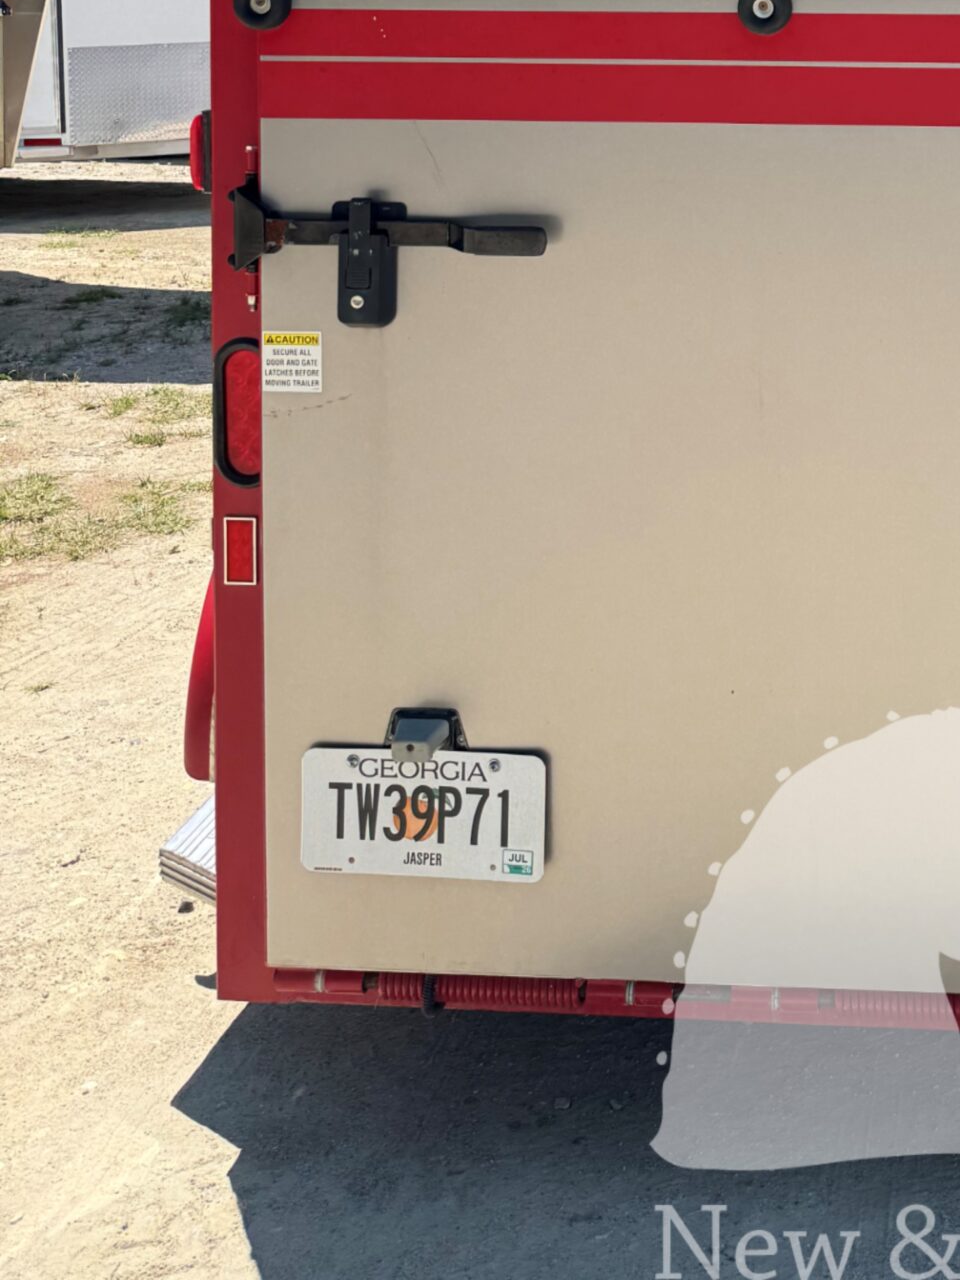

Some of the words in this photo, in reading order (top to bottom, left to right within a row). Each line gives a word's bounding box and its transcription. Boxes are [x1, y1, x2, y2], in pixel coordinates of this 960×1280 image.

[274, 335, 319, 344] CAUTION
[301, 359, 318, 367] GATE
[294, 369, 319, 377] BEFORE
[265, 379, 291, 387] MOVING
[292, 379, 320, 387] TRAILER
[358, 757, 488, 782] GEORGIA
[328, 781, 510, 848] TW39P71
[403, 851, 442, 866] JASPER
[508, 853, 529, 863] JUL
